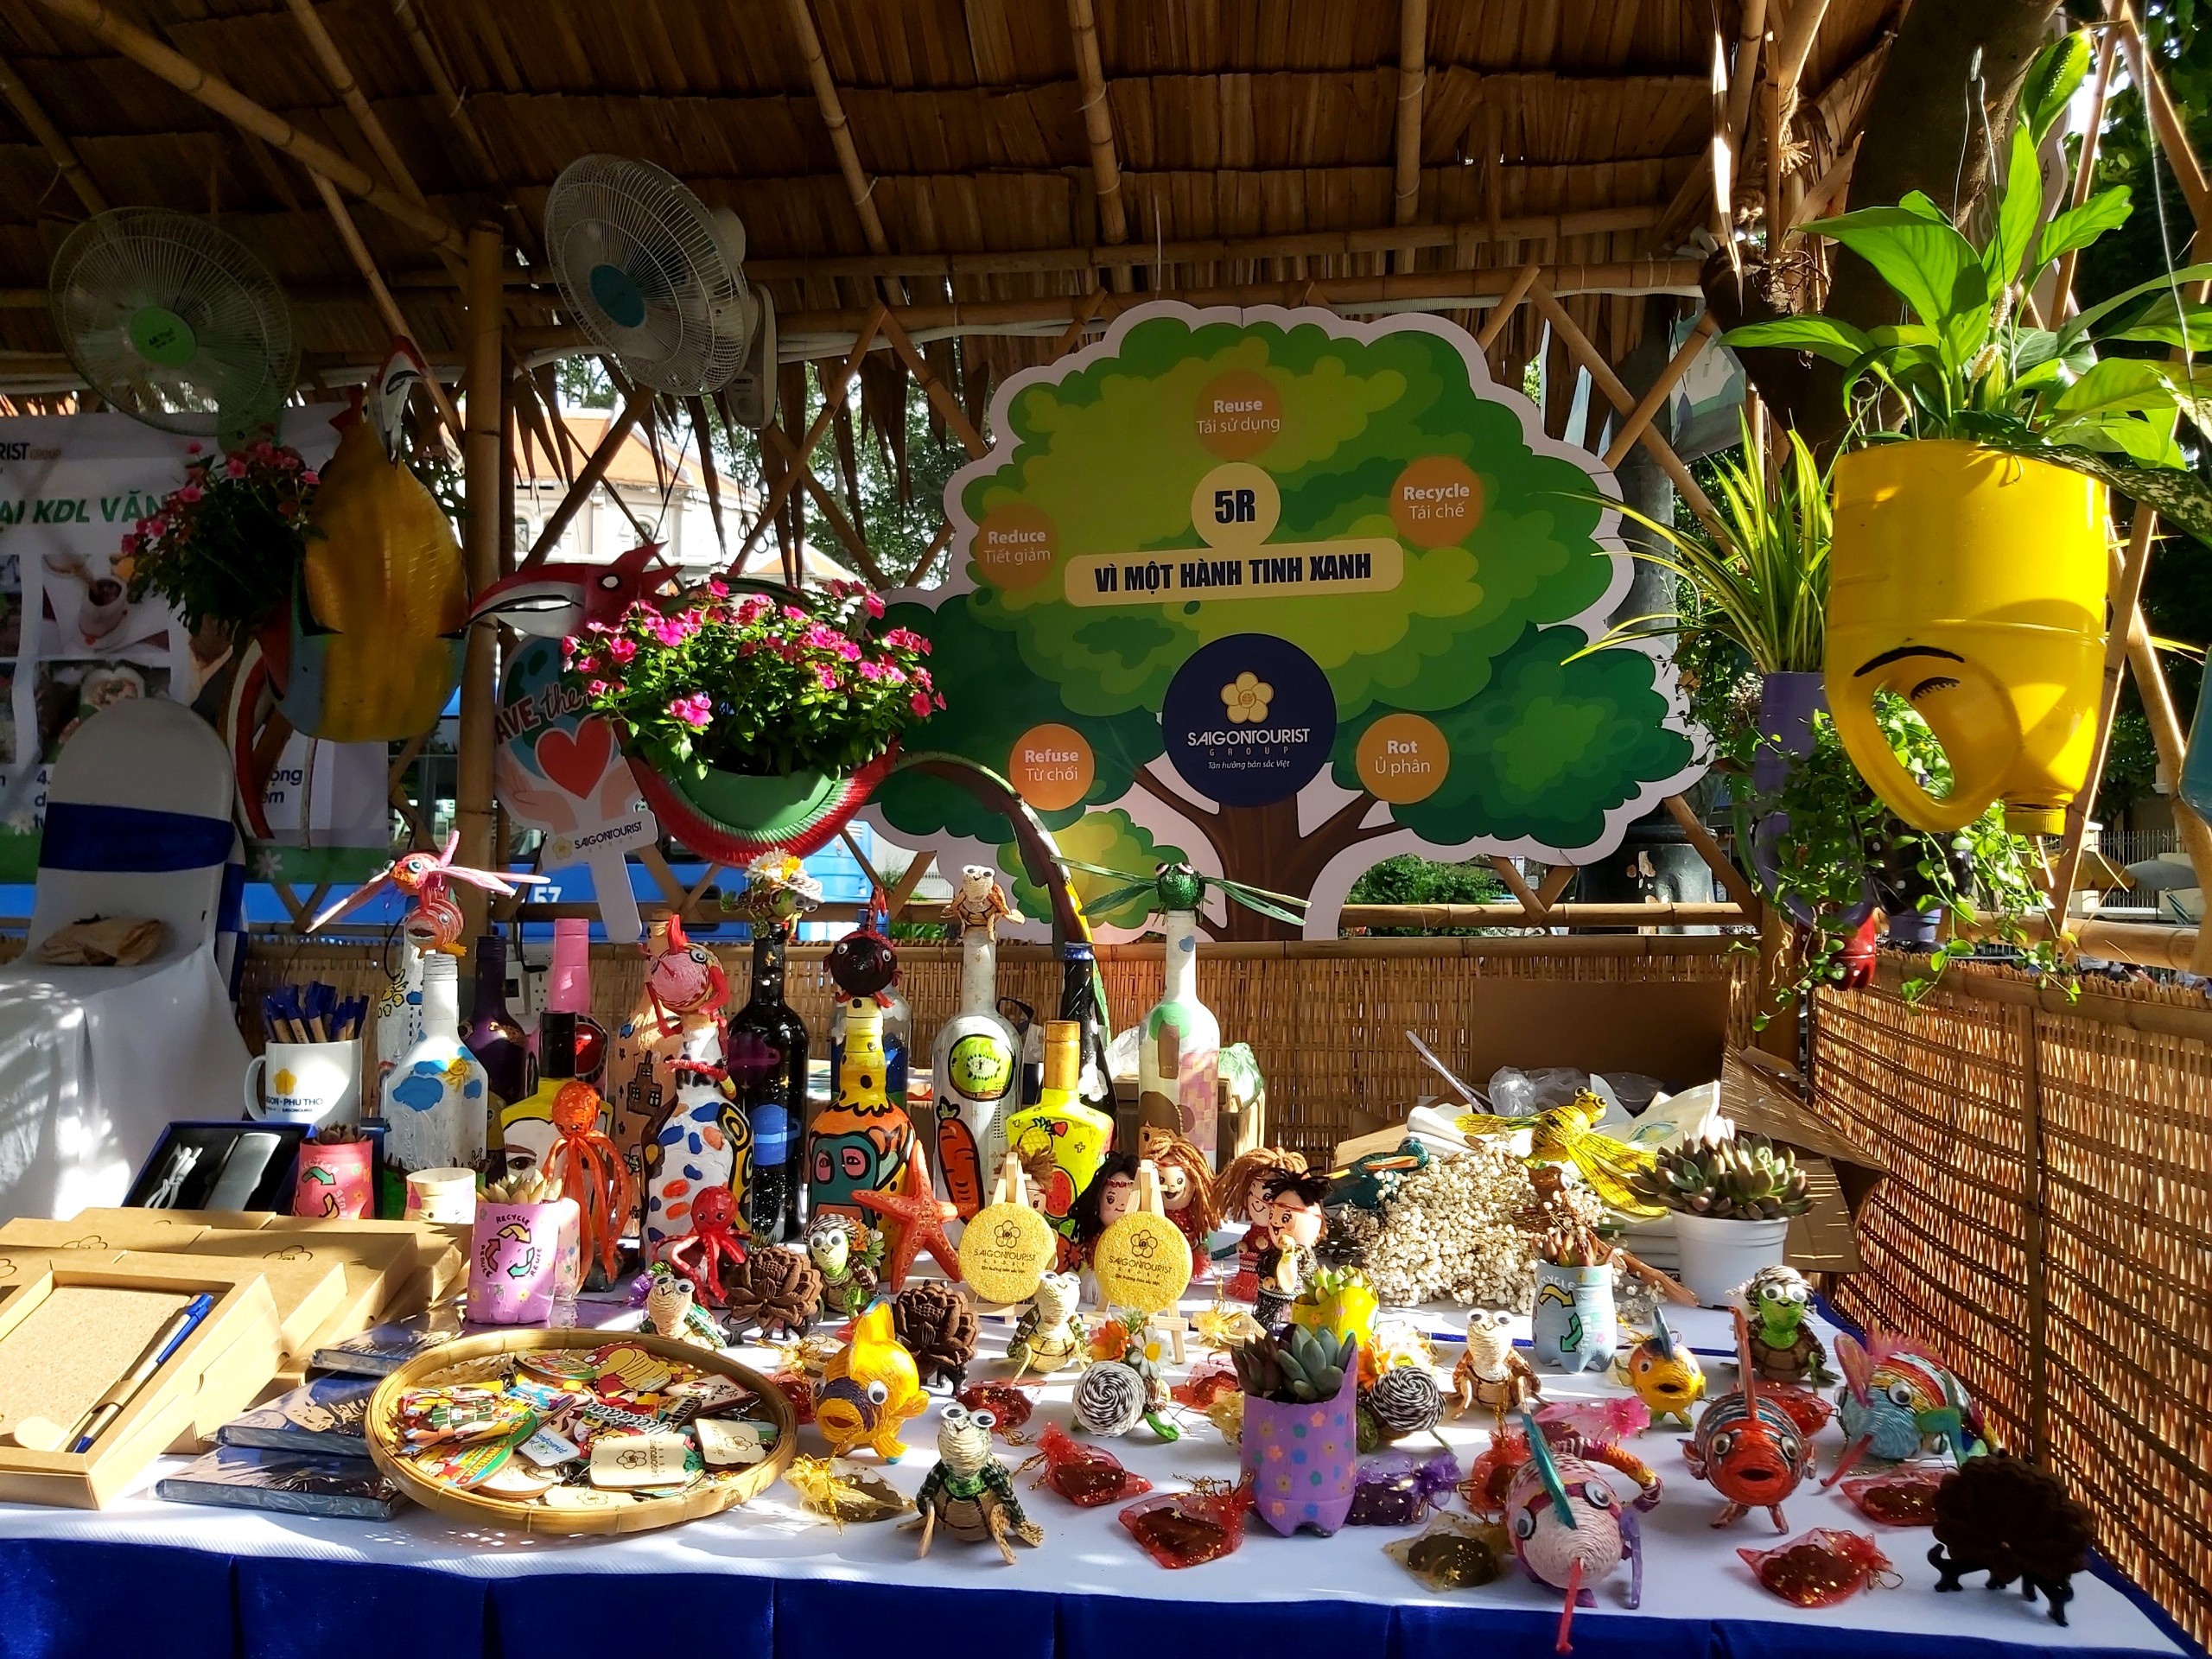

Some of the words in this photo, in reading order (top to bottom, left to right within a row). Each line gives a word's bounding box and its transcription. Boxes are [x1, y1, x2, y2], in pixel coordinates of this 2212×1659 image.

[1213, 399, 1262, 414] Reuse
[1196, 420, 1217, 435] Tái
[1220, 417, 1238, 433] sử
[1241, 416, 1281, 434] dụng
[1403, 483, 1470, 503] Recycle
[32, 499, 90, 524] KDL
[1214, 489, 1255, 524] 5R
[1408, 505, 1431, 519] Tái
[1435, 501, 1465, 518] chế
[988, 529, 1046, 545] Reduce
[983, 547, 1010, 564] Tiết
[1014, 547, 1051, 566] giảm
[1094, 563, 1117, 593] VÌ
[1124, 560, 1173, 595] MỘT
[1180, 557, 1243, 588] HÀNH
[1248, 556, 1303, 585] TINH
[1309, 553, 1371, 582] XANH
[494, 696, 540, 745] AVE
[539, 683, 582, 718] the
[1187, 728, 1311, 747] SAIGONTOURIST
[1387, 740, 1418, 754] Rot
[1025, 748, 1079, 763] Refuse
[1209, 746, 1288, 756] GROUP
[1025, 768, 1044, 781] Từ
[1047, 766, 1078, 781] chối
[1222, 760, 1246, 771] hưởng
[1247, 760, 1261, 769] bản
[1262, 759, 1274, 768] sắc
[1276, 760, 1290, 769] Việt
[1375, 755, 1386, 774] Ủ
[1390, 759, 1431, 778] phân
[575, 821, 643, 849] SAIGONTOURIST
[495, 1213, 531, 1227] RECYCLE
[480, 1244, 493, 1279] REDUCE
[530, 1247, 543, 1278] REUSE
[973, 1248, 1037, 1262] SAIGONTOURIST
[1108, 1255, 1173, 1274] SAIGONTOURIST
[586, 1402, 673, 1436] Vietnam
[465, 1444, 504, 1478] VIETNAM
